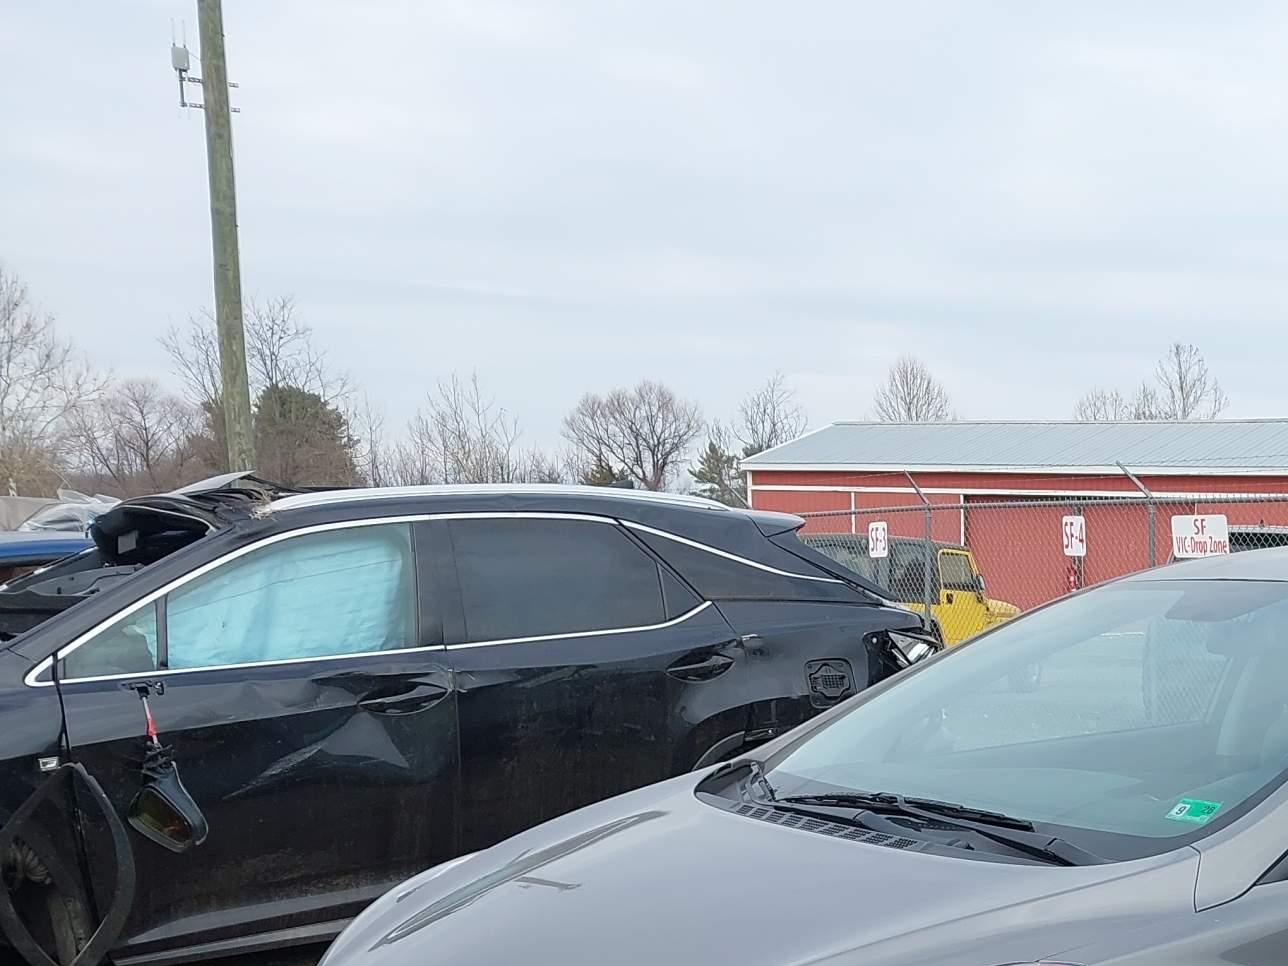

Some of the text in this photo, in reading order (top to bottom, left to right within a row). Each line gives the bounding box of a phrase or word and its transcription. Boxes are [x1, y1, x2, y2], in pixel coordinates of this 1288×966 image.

[1064, 520, 1085, 550] SF-4
[1193, 518, 1207, 536] SF
[870, 526, 886, 552] SF-3
[1175, 535, 1228, 556] VIC-Drop Zone
